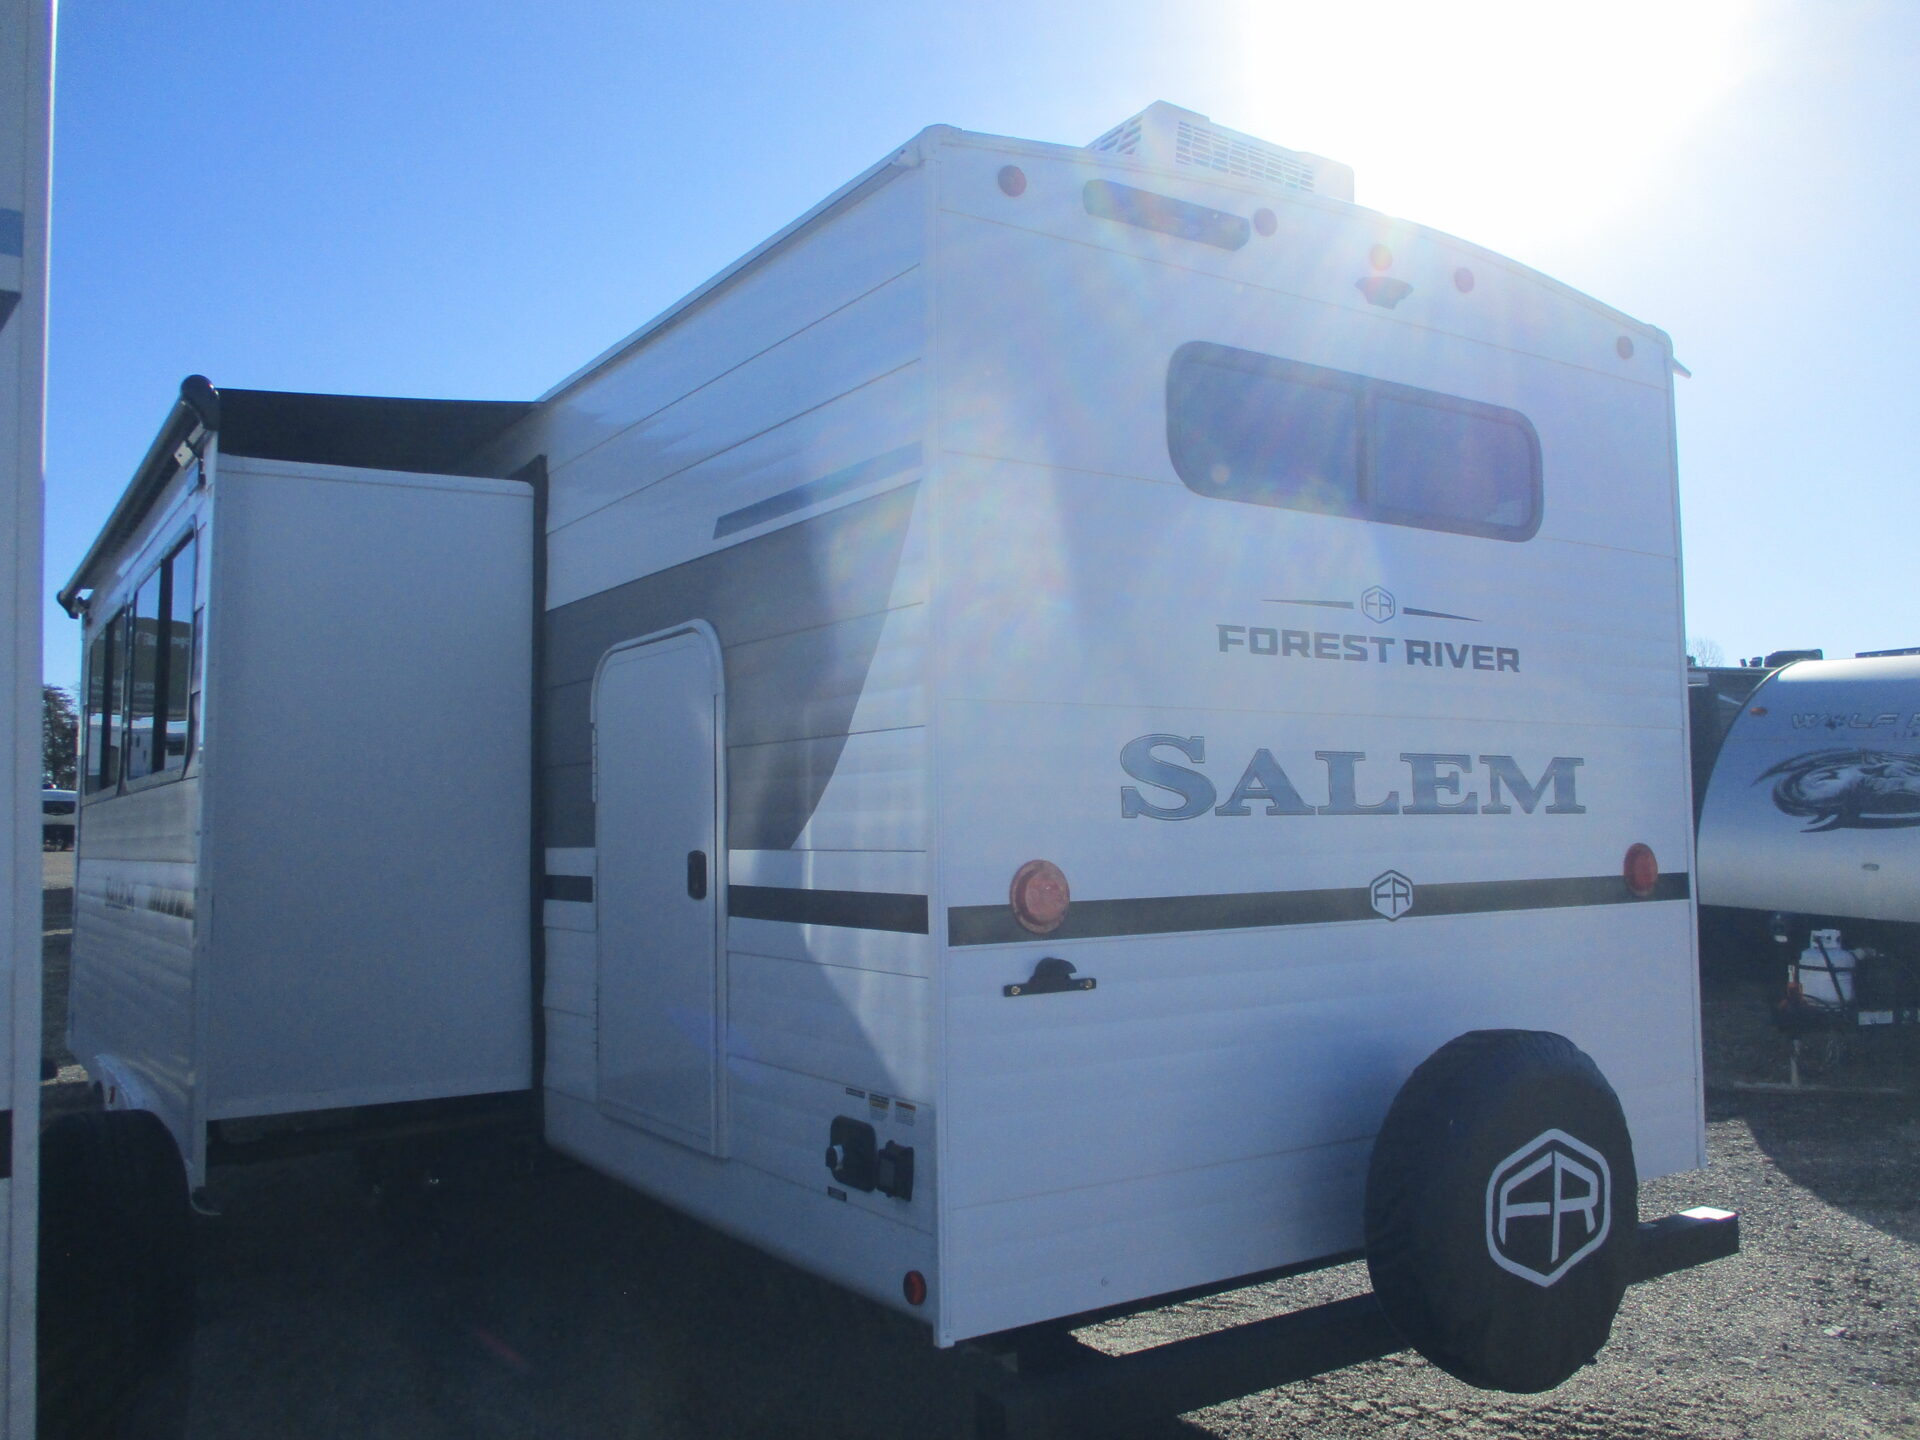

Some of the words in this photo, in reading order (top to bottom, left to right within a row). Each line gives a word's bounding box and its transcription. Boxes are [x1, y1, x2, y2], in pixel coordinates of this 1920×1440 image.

[1216, 624, 1395, 664] FOREST
[1403, 639, 1521, 673] RIVER
[1792, 713, 1900, 730] WLF
[1120, 733, 1587, 822] SALEM
